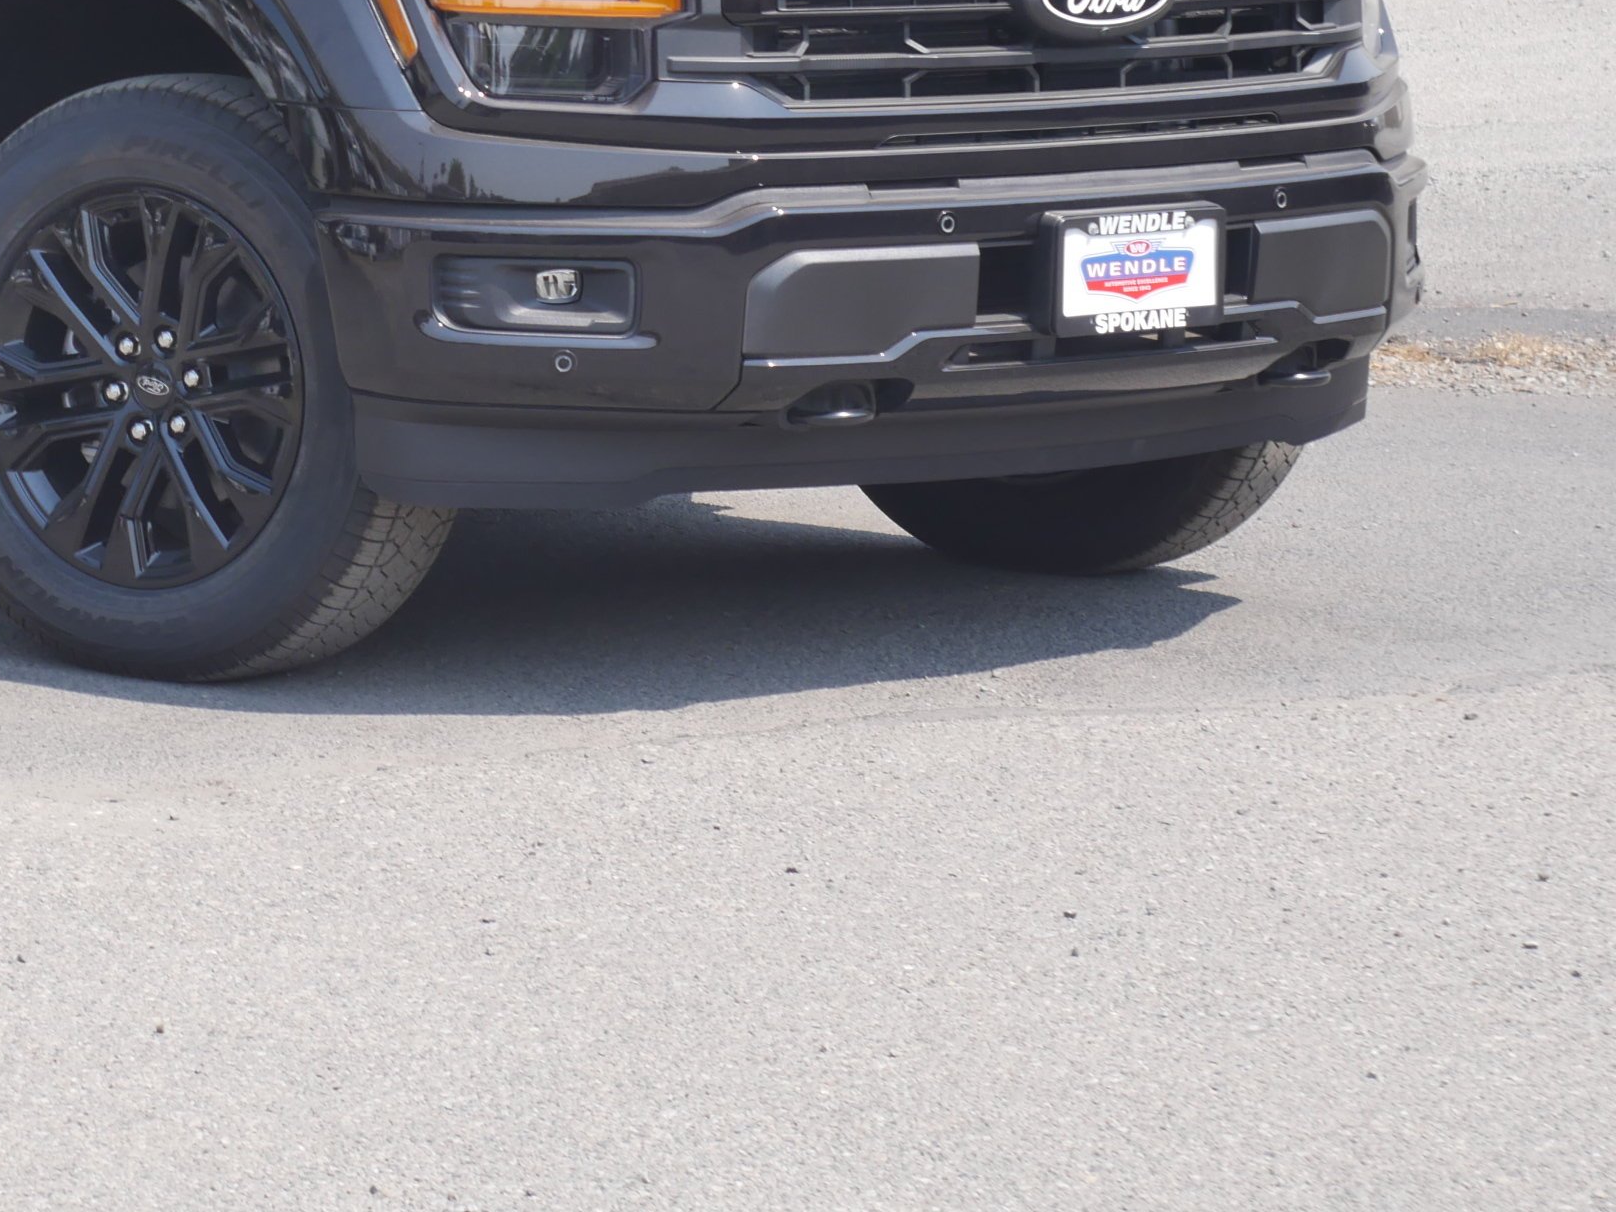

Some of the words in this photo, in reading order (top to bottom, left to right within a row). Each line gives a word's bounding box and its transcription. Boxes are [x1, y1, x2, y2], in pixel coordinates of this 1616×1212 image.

[1098, 212, 1187, 235] WENDLE
[1086, 256, 1187, 278] WENDLE
[1095, 308, 1187, 334] SPOKANE
